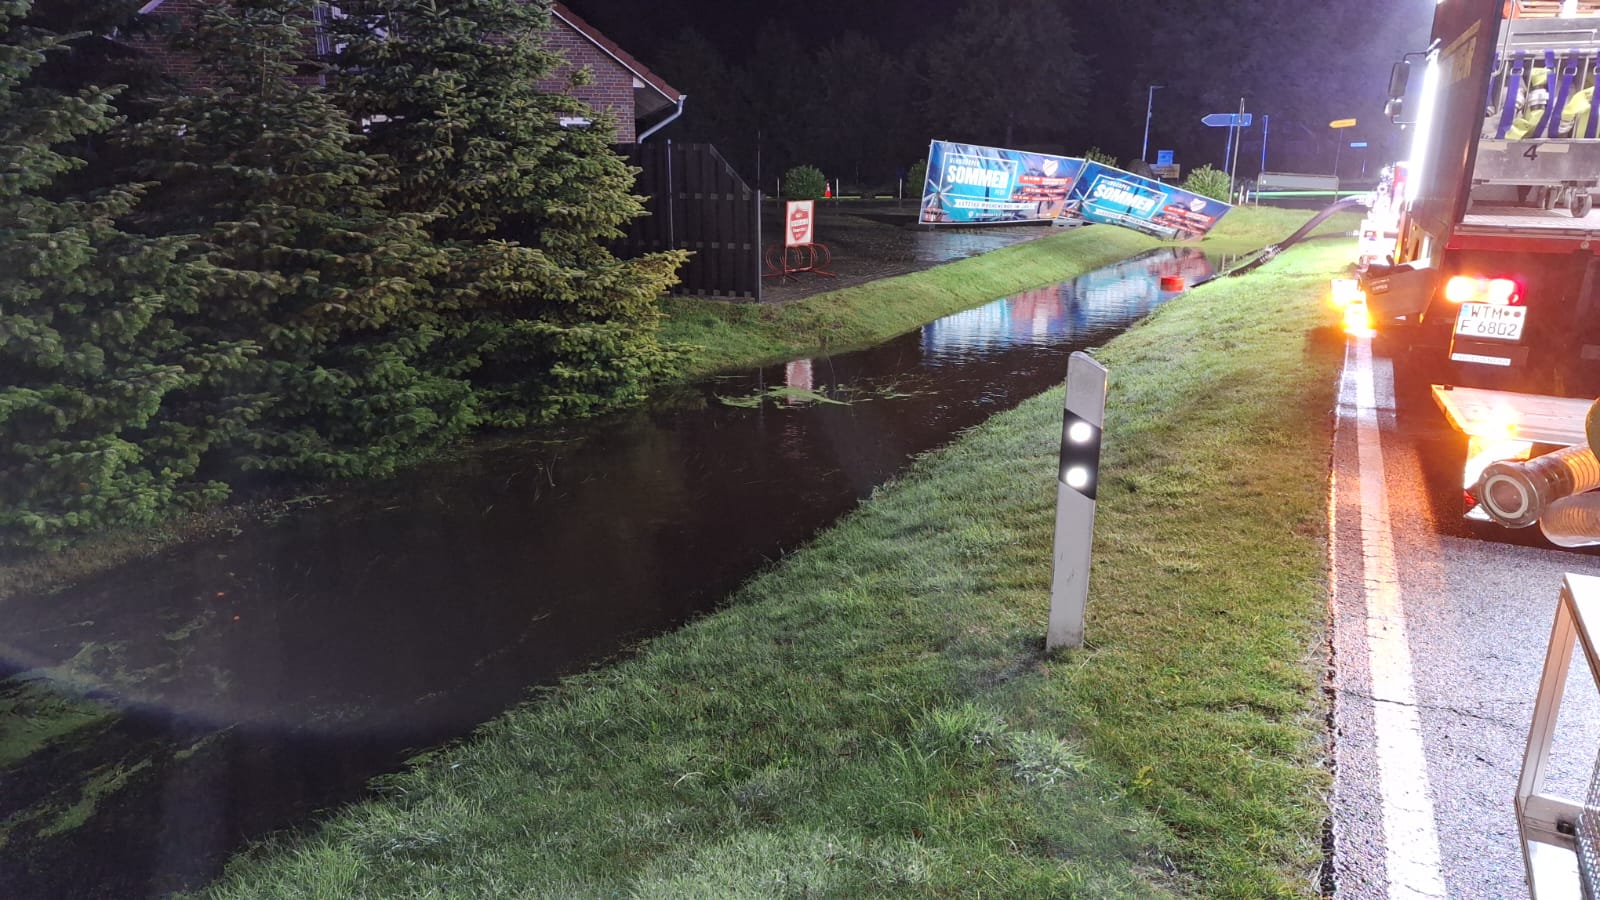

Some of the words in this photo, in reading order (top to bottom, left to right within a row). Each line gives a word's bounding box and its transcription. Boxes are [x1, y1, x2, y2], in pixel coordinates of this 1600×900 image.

[1523, 144, 1538, 161] 4
[946, 165, 1010, 189] SOMMER
[1093, 183, 1156, 213] SOMMER
[1471, 305, 1503, 320] WTM
[1460, 319, 1472, 332] F
[1477, 320, 1518, 337] 6802
